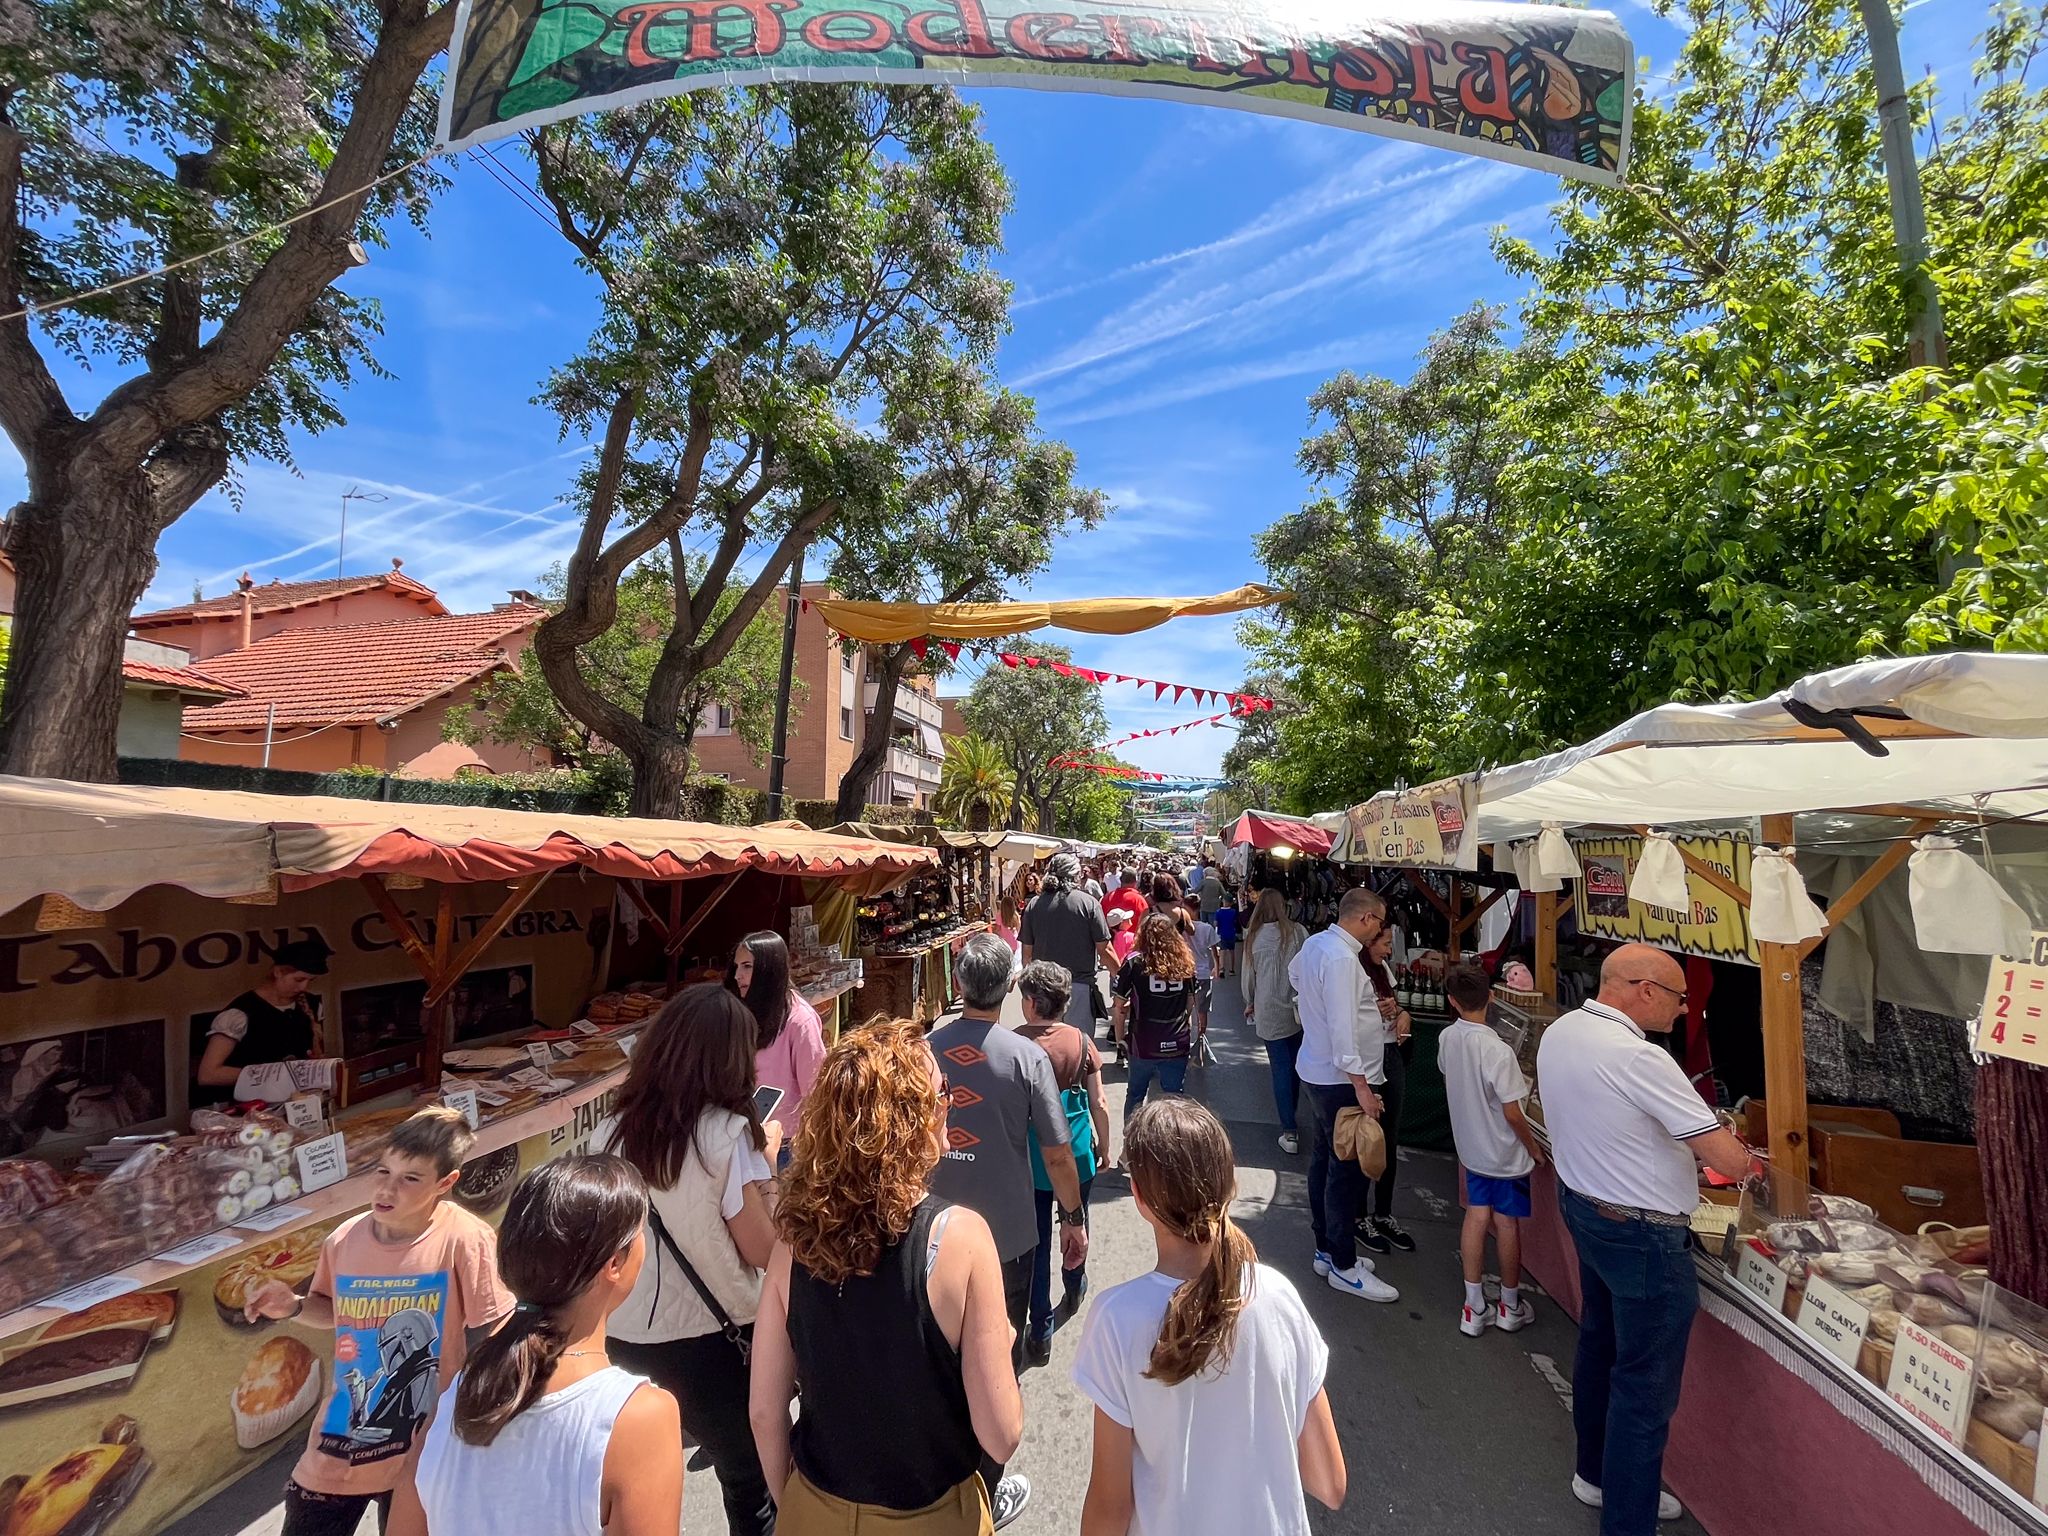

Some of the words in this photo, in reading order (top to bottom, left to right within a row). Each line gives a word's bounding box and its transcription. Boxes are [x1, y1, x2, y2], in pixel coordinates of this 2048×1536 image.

[1394, 821, 1404, 835] la
[1406, 837, 1424, 858] Bas
[1694, 900, 1718, 925] Bas
[2004, 970, 2014, 991] 1
[1995, 995, 2011, 1018] 2
[1991, 1022, 2006, 1044] 4
[945, 1150, 976, 1162] mbro
[349, 1279, 381, 1288] STAR
[384, 1278, 420, 1288] WARS
[1749, 1260, 1762, 1273] CAP
[1766, 1273, 1775, 1286] DE
[1748, 1275, 1770, 1296] LLOM
[1805, 1292, 1827, 1313] LLOM
[1815, 1317, 1842, 1342] DUROC
[1930, 1341, 1966, 1371] EUROS
[1909, 1355, 1952, 1392] BULL
[1904, 1372, 1951, 1411] BLANC
